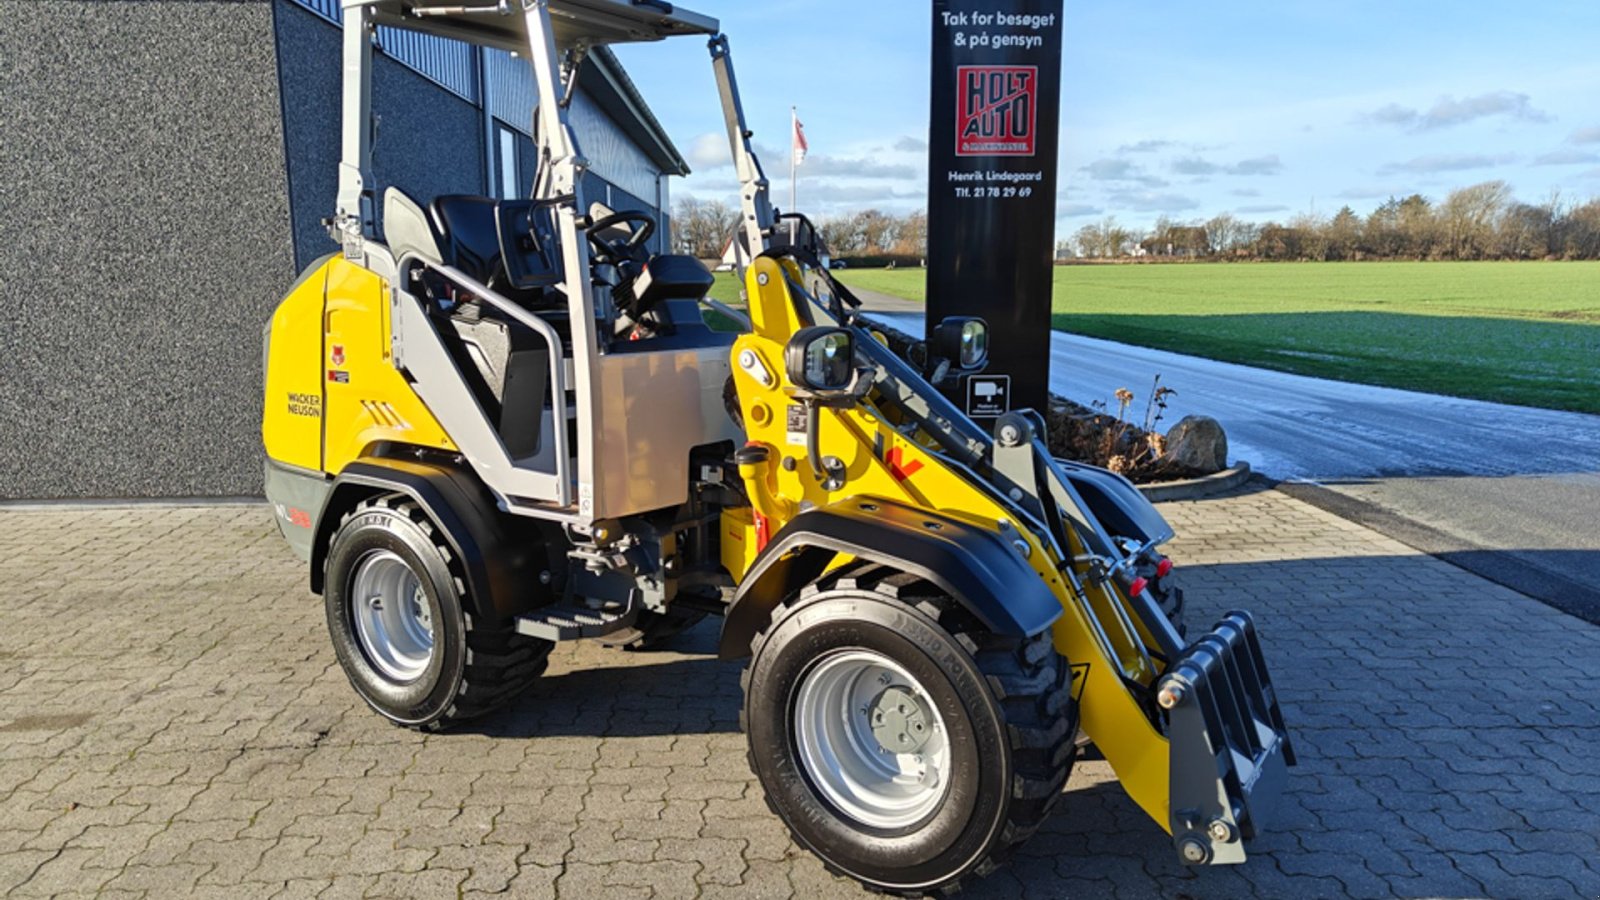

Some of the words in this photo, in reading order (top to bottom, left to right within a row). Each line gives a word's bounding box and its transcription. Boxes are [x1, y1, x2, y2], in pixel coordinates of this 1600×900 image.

[942, 12, 968, 26] Tak
[972, 11, 994, 26] for
[997, 11, 1055, 29] besøget
[954, 32, 966, 46] &
[969, 31, 989, 49] på
[992, 35, 1042, 50] gensyn
[967, 71, 1031, 118] HOLT
[962, 92, 1030, 138] AUTO
[948, 171, 984, 181] Henrik
[986, 171, 1042, 183] Lindegaard
[973, 187, 985, 198] 21
[987, 187, 1000, 198] 78
[1003, 187, 1016, 198] 29
[1018, 187, 1032, 198] 69
[287, 392, 320, 405] WACKER
[288, 403, 320, 417] NEUSON
